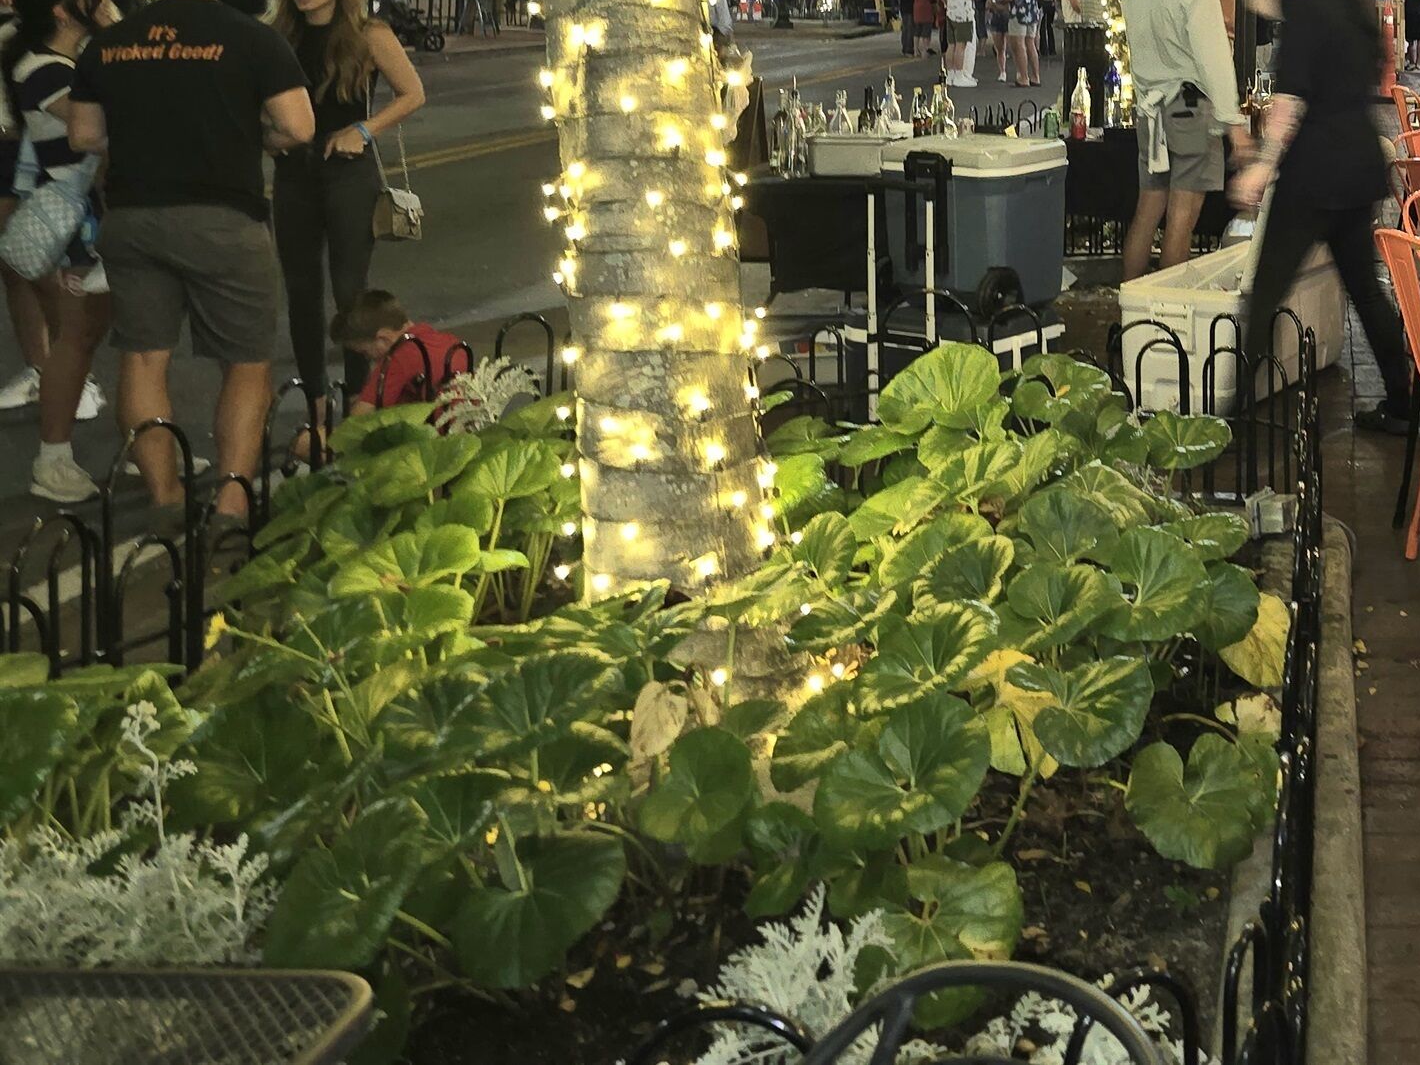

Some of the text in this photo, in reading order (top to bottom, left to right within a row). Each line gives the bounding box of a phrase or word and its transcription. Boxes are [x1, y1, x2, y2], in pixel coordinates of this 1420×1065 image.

[147, 24, 178, 41] It's
[102, 42, 224, 64] Wicked Good!
